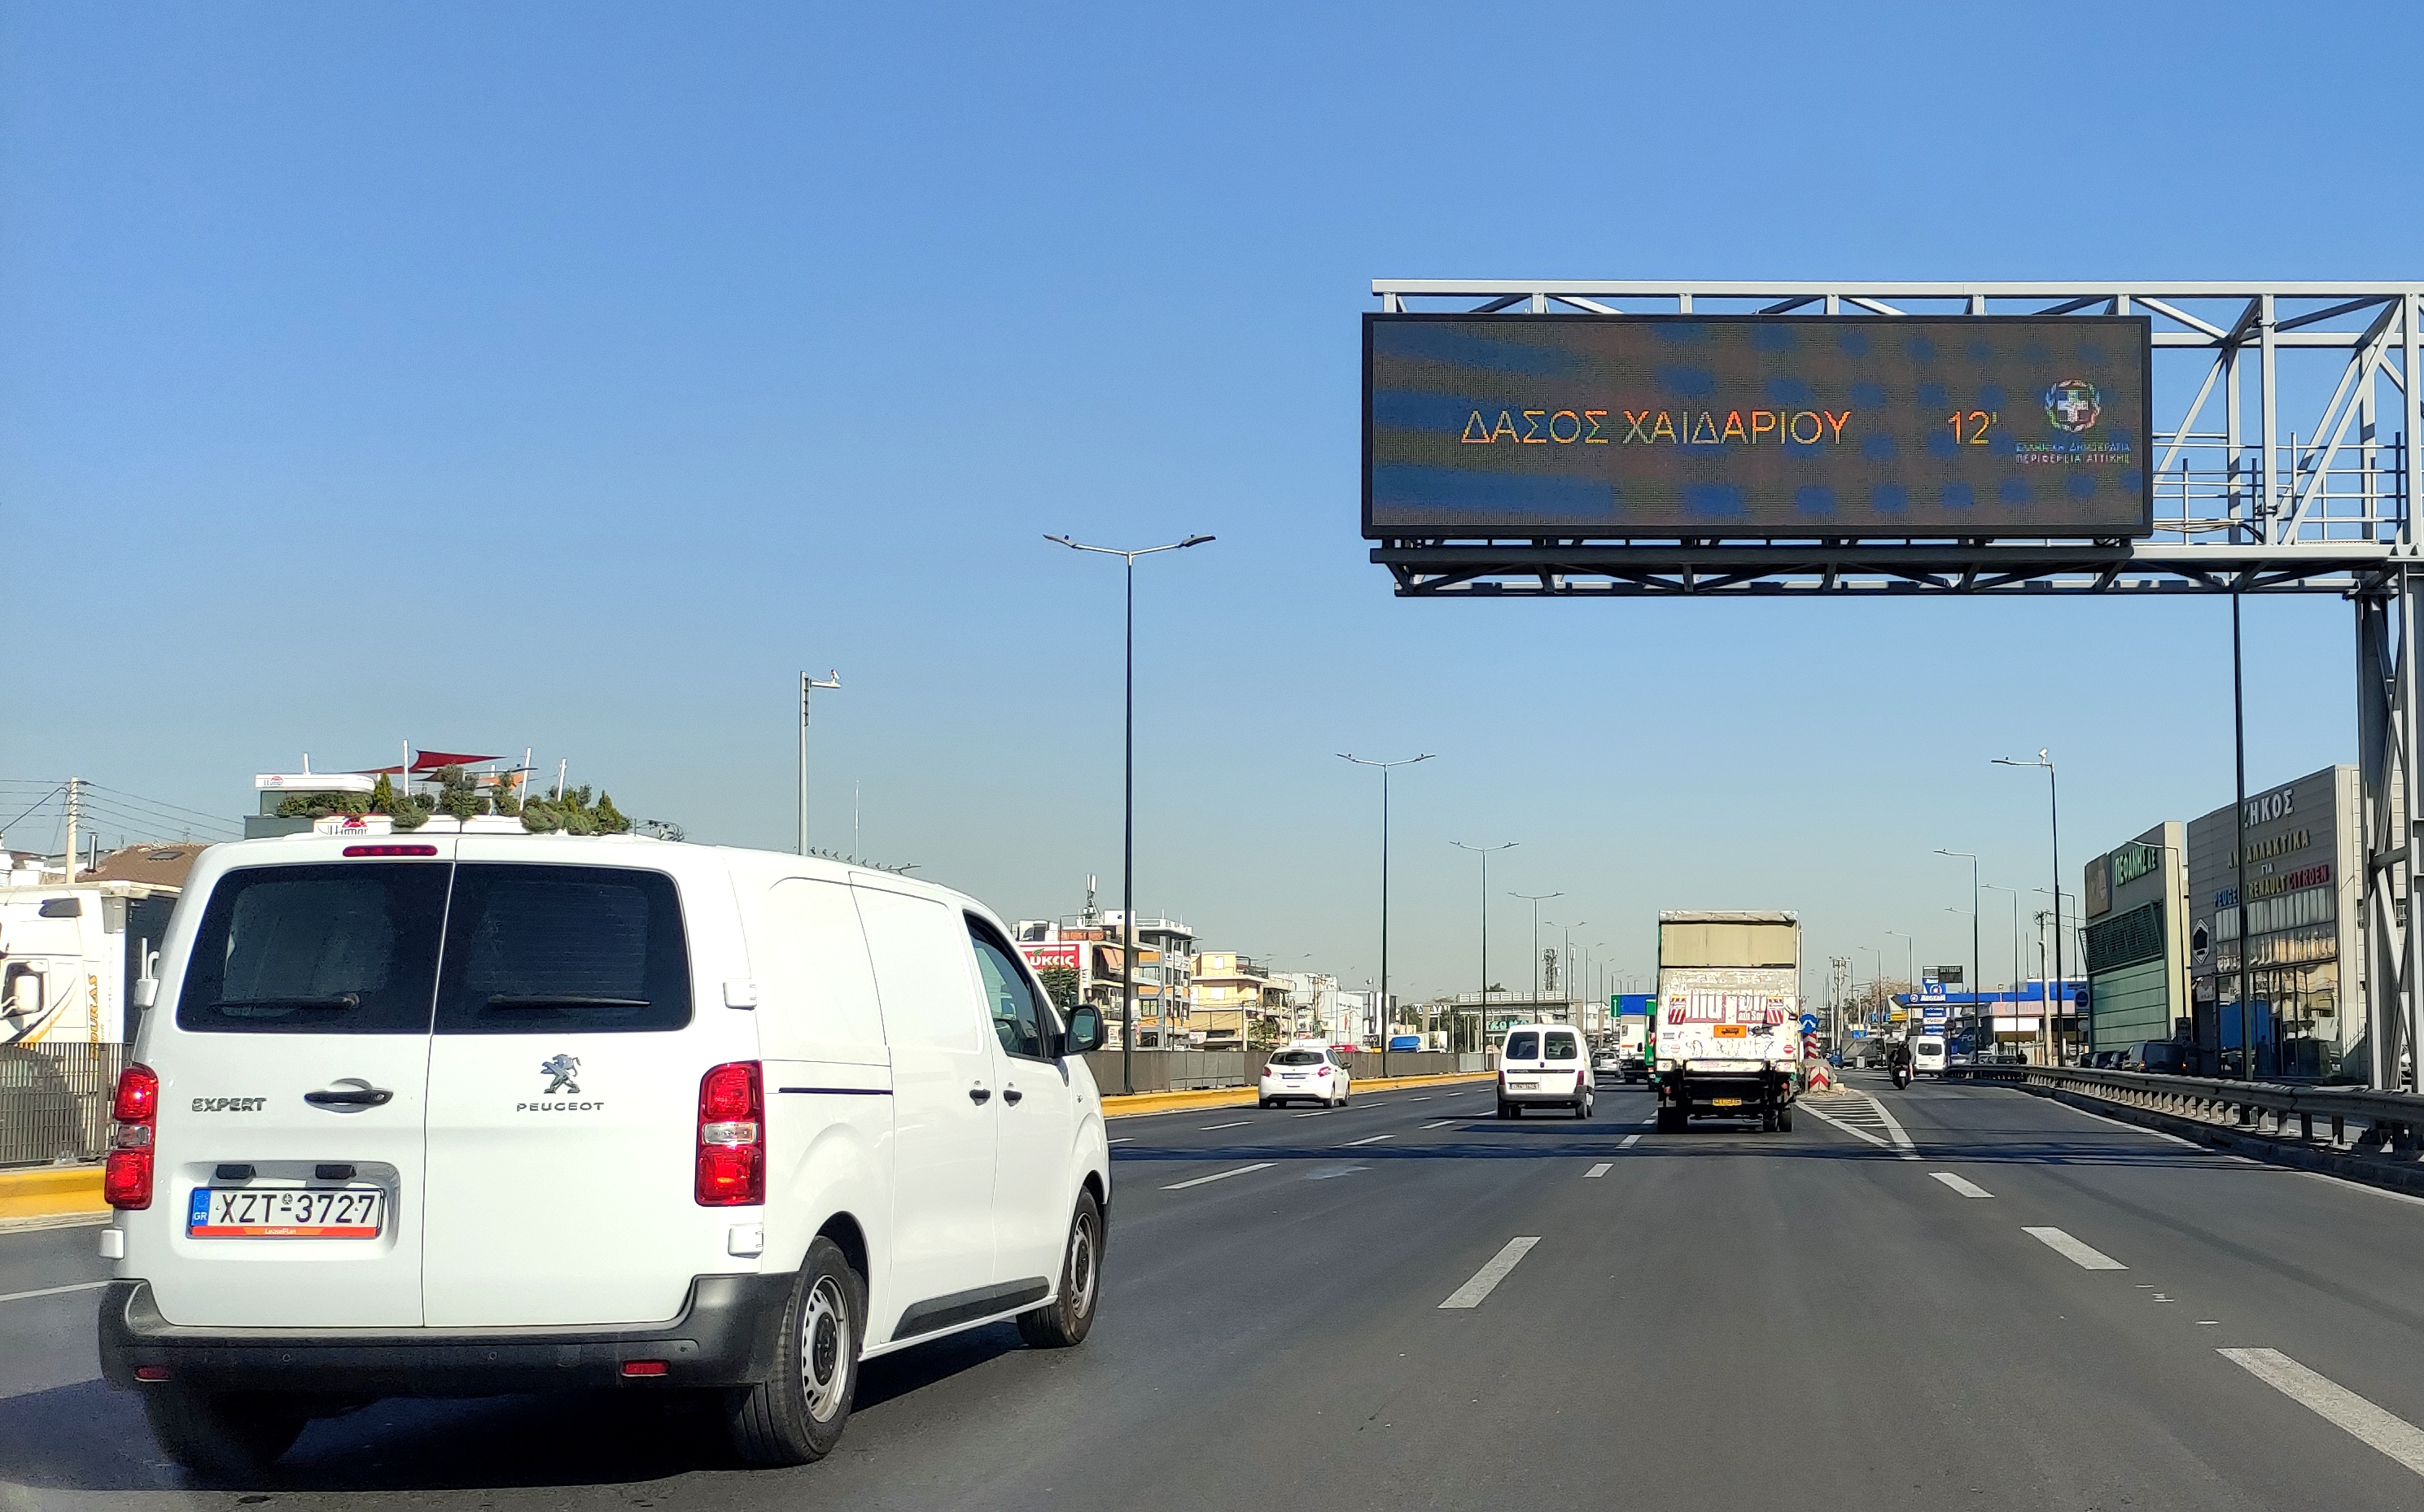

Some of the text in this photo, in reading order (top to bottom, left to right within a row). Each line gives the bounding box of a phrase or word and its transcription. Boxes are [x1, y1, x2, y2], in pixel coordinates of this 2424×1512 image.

[1461, 409, 1608, 444] ΔΑΣΟΣ
[1622, 410, 1852, 444] ΧΑΙΔΑΡΙΟΥ
[2228, 829, 2311, 869] ΑΝΑΛΛΑΚΤΙΚΑ
[2115, 846, 2147, 887] ΠΕΦΑΝΗΣ
[2261, 863, 2274, 876] ΓΙΑ
[2215, 886, 2240, 909] PEUGE
[2247, 875, 2287, 900] RENAULT
[191, 1097, 268, 1112] EXPERT
[516, 1102, 605, 1112] PEUGEOT
[193, 1211, 208, 1221] GR
